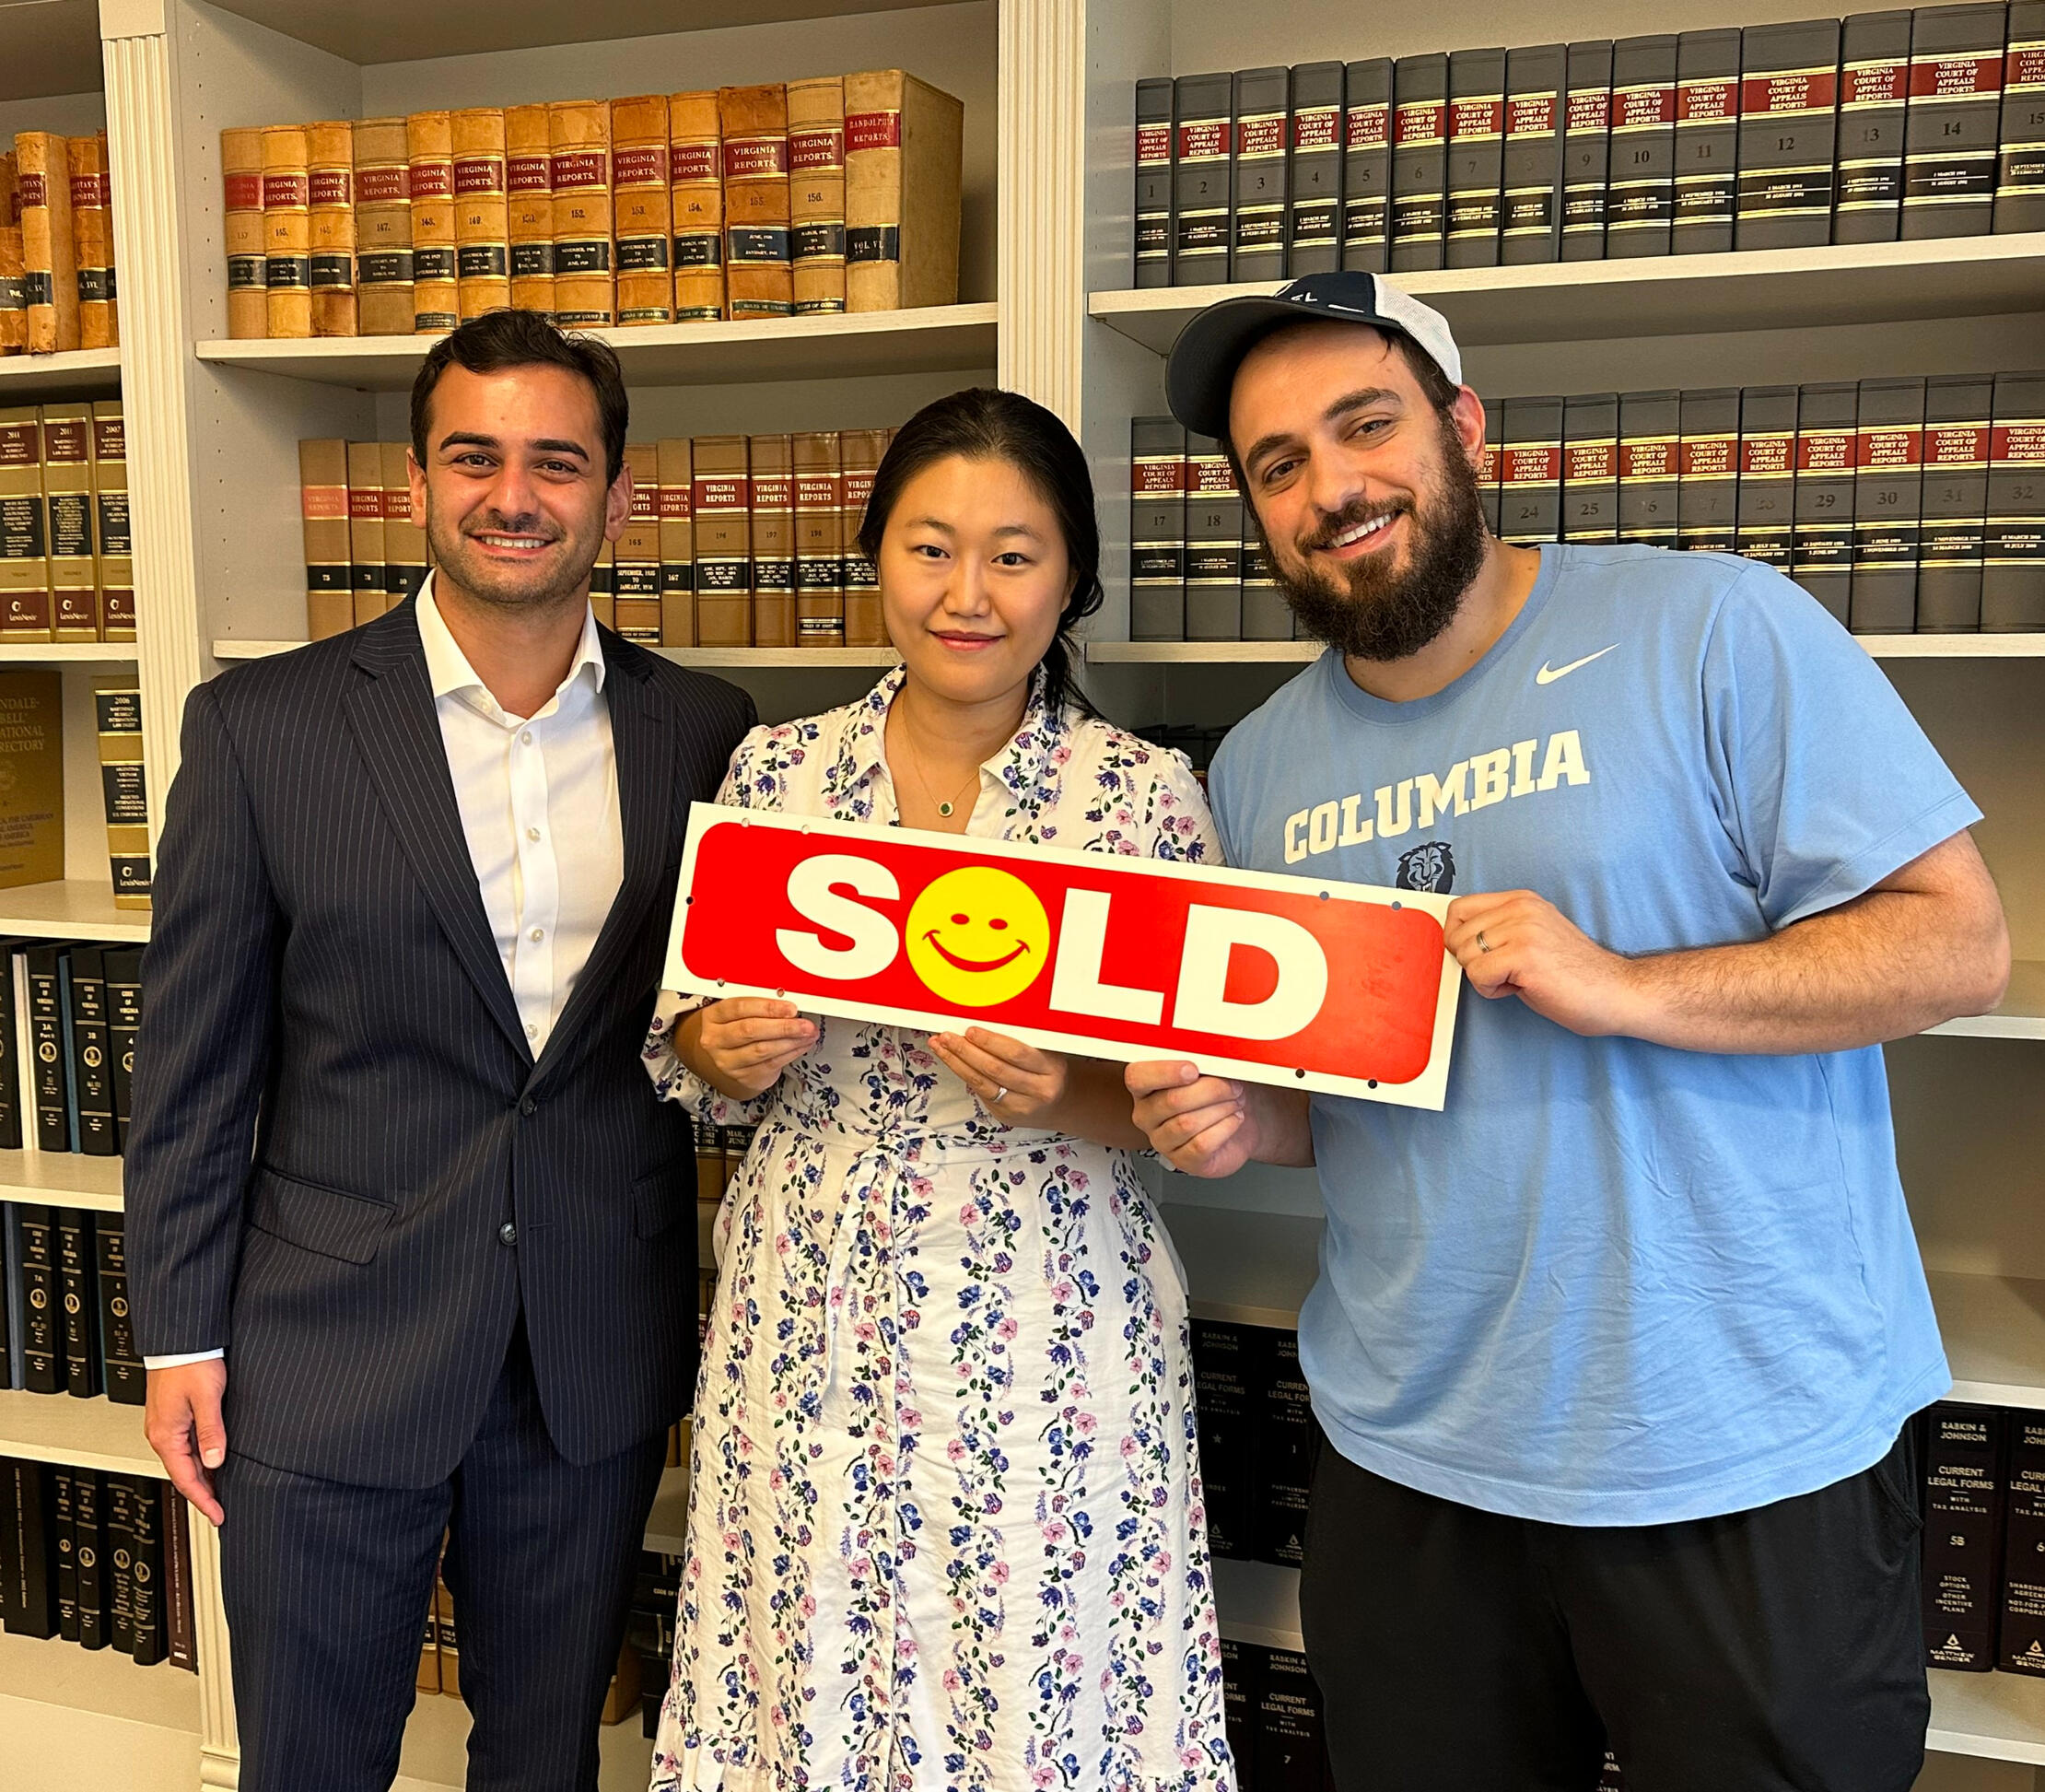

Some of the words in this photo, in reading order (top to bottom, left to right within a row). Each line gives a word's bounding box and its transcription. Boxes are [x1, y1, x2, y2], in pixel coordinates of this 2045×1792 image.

[1938, 61, 1976, 69] VIRGINIA
[1935, 69, 1964, 78] COURT
[1770, 77, 1807, 87] VIRGINIA
[1937, 77, 1975, 87] APPEALS
[1626, 91, 1661, 100] VIRGINIA
[1768, 86, 1795, 95] COURT
[1936, 86, 1975, 95] REPORTS
[1770, 93, 1806, 102] APPEALS
[1458, 103, 1491, 111] VIRGINIA
[1623, 100, 1649, 110] COURT
[1770, 101, 1806, 111] REPORTS
[1456, 111, 1481, 120] COURT
[1625, 107, 1660, 117] APPEALS
[1301, 113, 1332, 122] VIRGINIA
[1625, 115, 1660, 124] REPORTS
[2030, 112, 2045, 124] 15
[1298, 122, 1322, 131] COURT
[1458, 119, 1491, 127] APPEALS
[1300, 129, 1332, 138] APPEALS
[1458, 126, 1491, 135] REPORTS
[1944, 122, 1961, 135] 14
[793, 138, 833, 148] VIRGINIA
[1300, 136, 1332, 146] REPORTS
[1778, 137, 1794, 151] 12
[733, 146, 776, 155] VIRGINIA
[1696, 145, 1711, 158] 11
[617, 154, 655, 165] VIRGINIA
[673, 151, 711, 161] VIRGINIA
[1583, 155, 1590, 166] 9
[1633, 150, 1649, 164] 10
[556, 158, 594, 170] VIRGINIA
[1468, 161, 1477, 173] 7
[458, 165, 493, 174] VIRGINIA
[1415, 167, 1422, 179] 6
[364, 174, 399, 182] VIRGINIA
[1312, 171, 1319, 182] 4
[1363, 170, 1370, 182] 5
[1200, 182, 1207, 193] 2
[1257, 178, 1265, 189] 3
[1150, 185, 1154, 197] 1
[1937, 430, 1976, 439] VIRGINIA
[1869, 441, 1897, 450] COURT
[1573, 448, 1607, 456] VIRGINIA
[1871, 456, 1908, 464] REPORTS
[1937, 453, 1975, 462] REPORTS
[1808, 460, 1845, 468] REPORTS
[800, 483, 832, 491] VIRGINIA
[800, 493, 832, 501] REPORTS
[1815, 495, 1835, 508] 29
[1877, 492, 1898, 505] 30
[1520, 507, 1538, 520] 24
[1581, 503, 1599, 515] 25
[1154, 516, 1165, 526] 17
[1207, 515, 1221, 526] 18
[1284, 730, 1590, 864] COLUMBIA
[1940, 1432, 1987, 1442] JOHNSON
[1938, 1466, 1984, 1476] CURRENT
[1927, 1477, 1959, 1487] LEGAL
[1960, 1479, 1993, 1490] FORMS
[1269, 1663, 1307, 1674] JOHNSON
[1269, 1692, 1306, 1704] CURRENT
[1261, 1702, 1286, 1713] LEGAL
[1287, 1706, 1315, 1717] FORMS
[1284, 1755, 1291, 1763] 7
